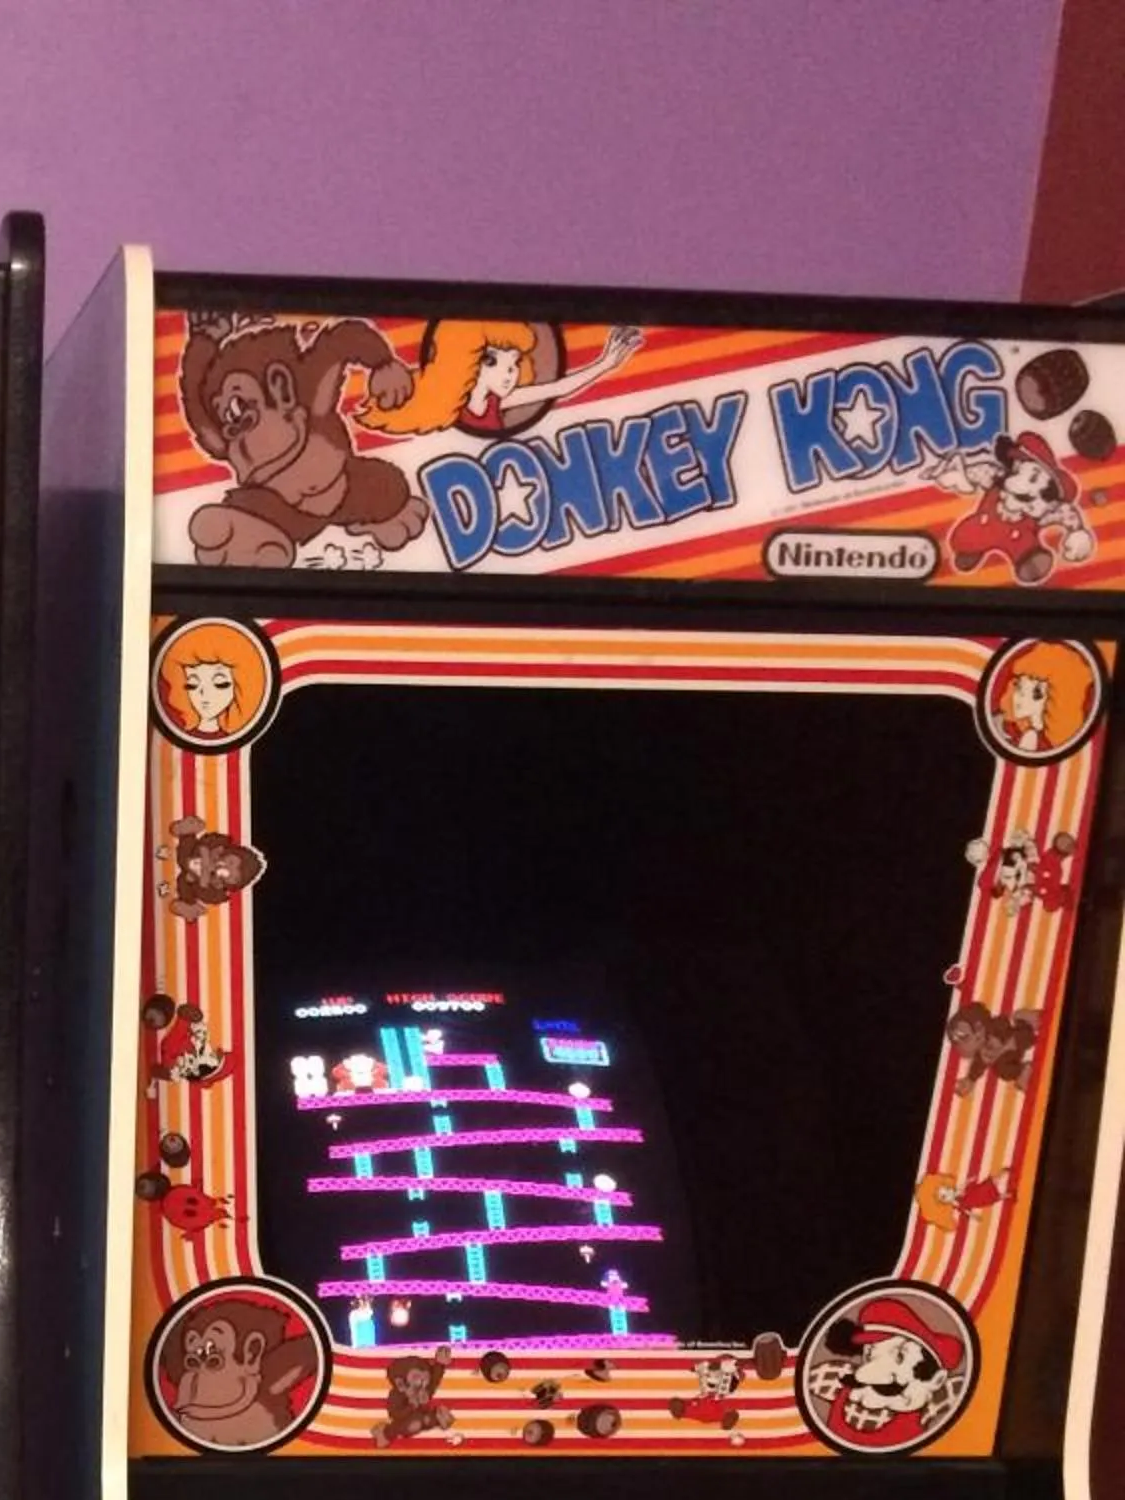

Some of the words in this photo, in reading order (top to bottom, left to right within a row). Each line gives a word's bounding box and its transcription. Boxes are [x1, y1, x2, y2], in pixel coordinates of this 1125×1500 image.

[417, 390, 749, 571] DONKEY
[768, 339, 1009, 495] KONG
[777, 540, 929, 569] Nintendo
